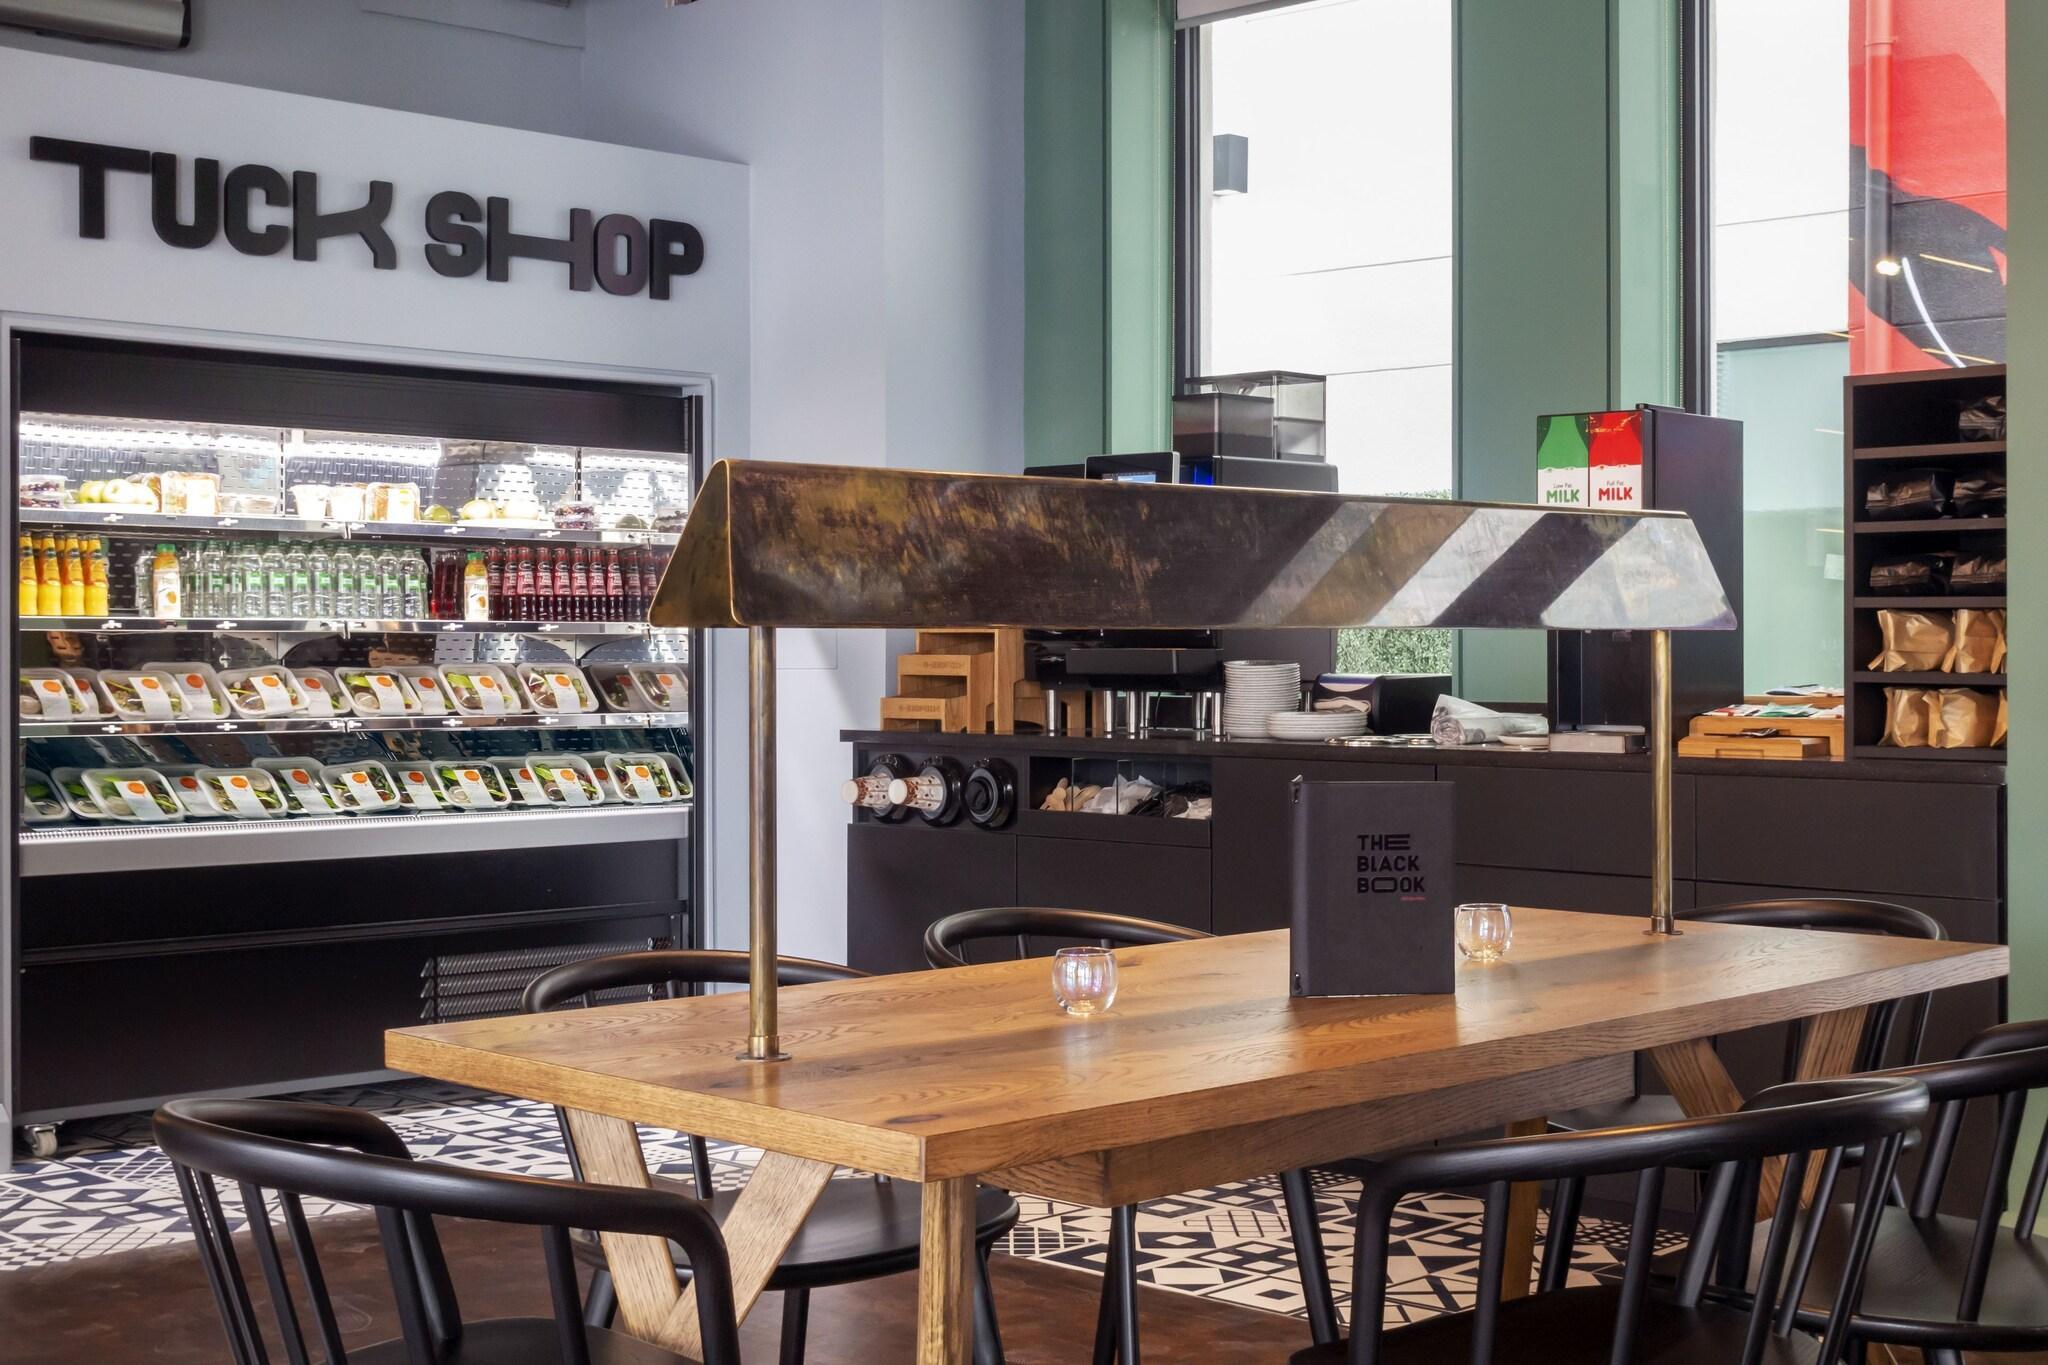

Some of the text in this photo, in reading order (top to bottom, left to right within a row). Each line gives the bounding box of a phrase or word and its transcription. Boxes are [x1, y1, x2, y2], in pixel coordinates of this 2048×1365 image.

[30, 135, 704, 300] TUCK SHOP
[1546, 489, 1580, 503] MILK
[1598, 487, 1633, 501] MILK
[1357, 833, 1411, 851] THE
[1357, 855, 1420, 872] BLACK
[1357, 876, 1426, 893] BOOK
